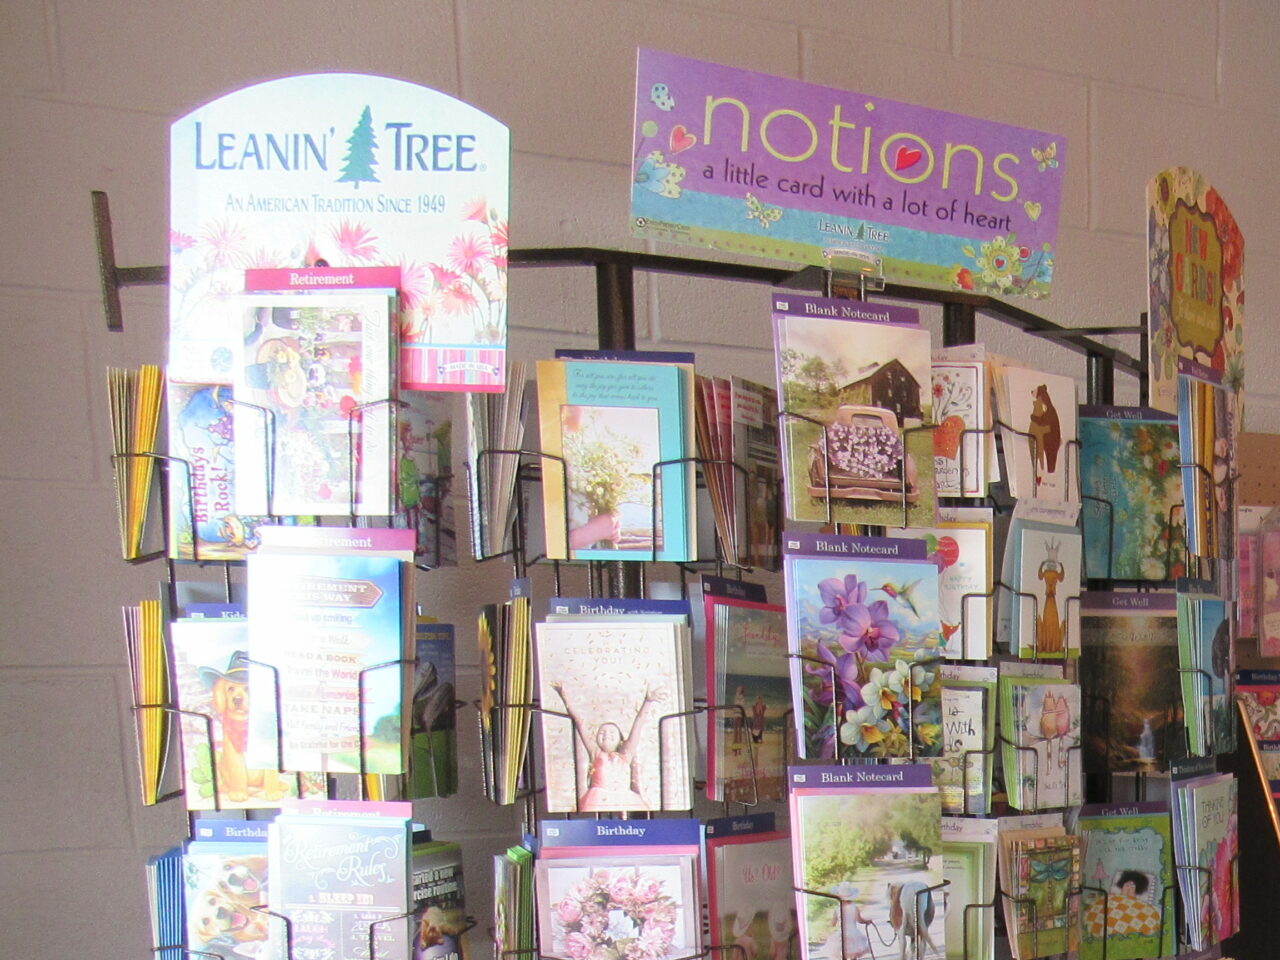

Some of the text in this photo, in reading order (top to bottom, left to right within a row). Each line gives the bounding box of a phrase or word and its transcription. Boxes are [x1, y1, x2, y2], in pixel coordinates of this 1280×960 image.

[194, 121, 478, 172] LEANIN' TREE
[704, 94, 1020, 203] notions
[703, 157, 1012, 232] a little card with a lot of heart
[224, 194, 445, 213] AN AMERICAN TRADITION SINCE 1949
[866, 225, 888, 242] TREE
[290, 273, 354, 286] Retirement
[805, 303, 890, 322] Blank Notecard
[1106, 410, 1143, 420] Get Well
[193, 447, 205, 523] Birthdays
[211, 466, 228, 512] Rock!
[816, 541, 898, 555] Blank Notecard
[1112, 597, 1149, 606] Get Well
[580, 605, 625, 614] Birthday
[821, 771, 904, 783] Blank Notecard
[1102, 807, 1139, 816] Get Well
[226, 827, 267, 837] Birthda
[596, 826, 646, 836] Birthday
[337, 852, 386, 887] Rules
